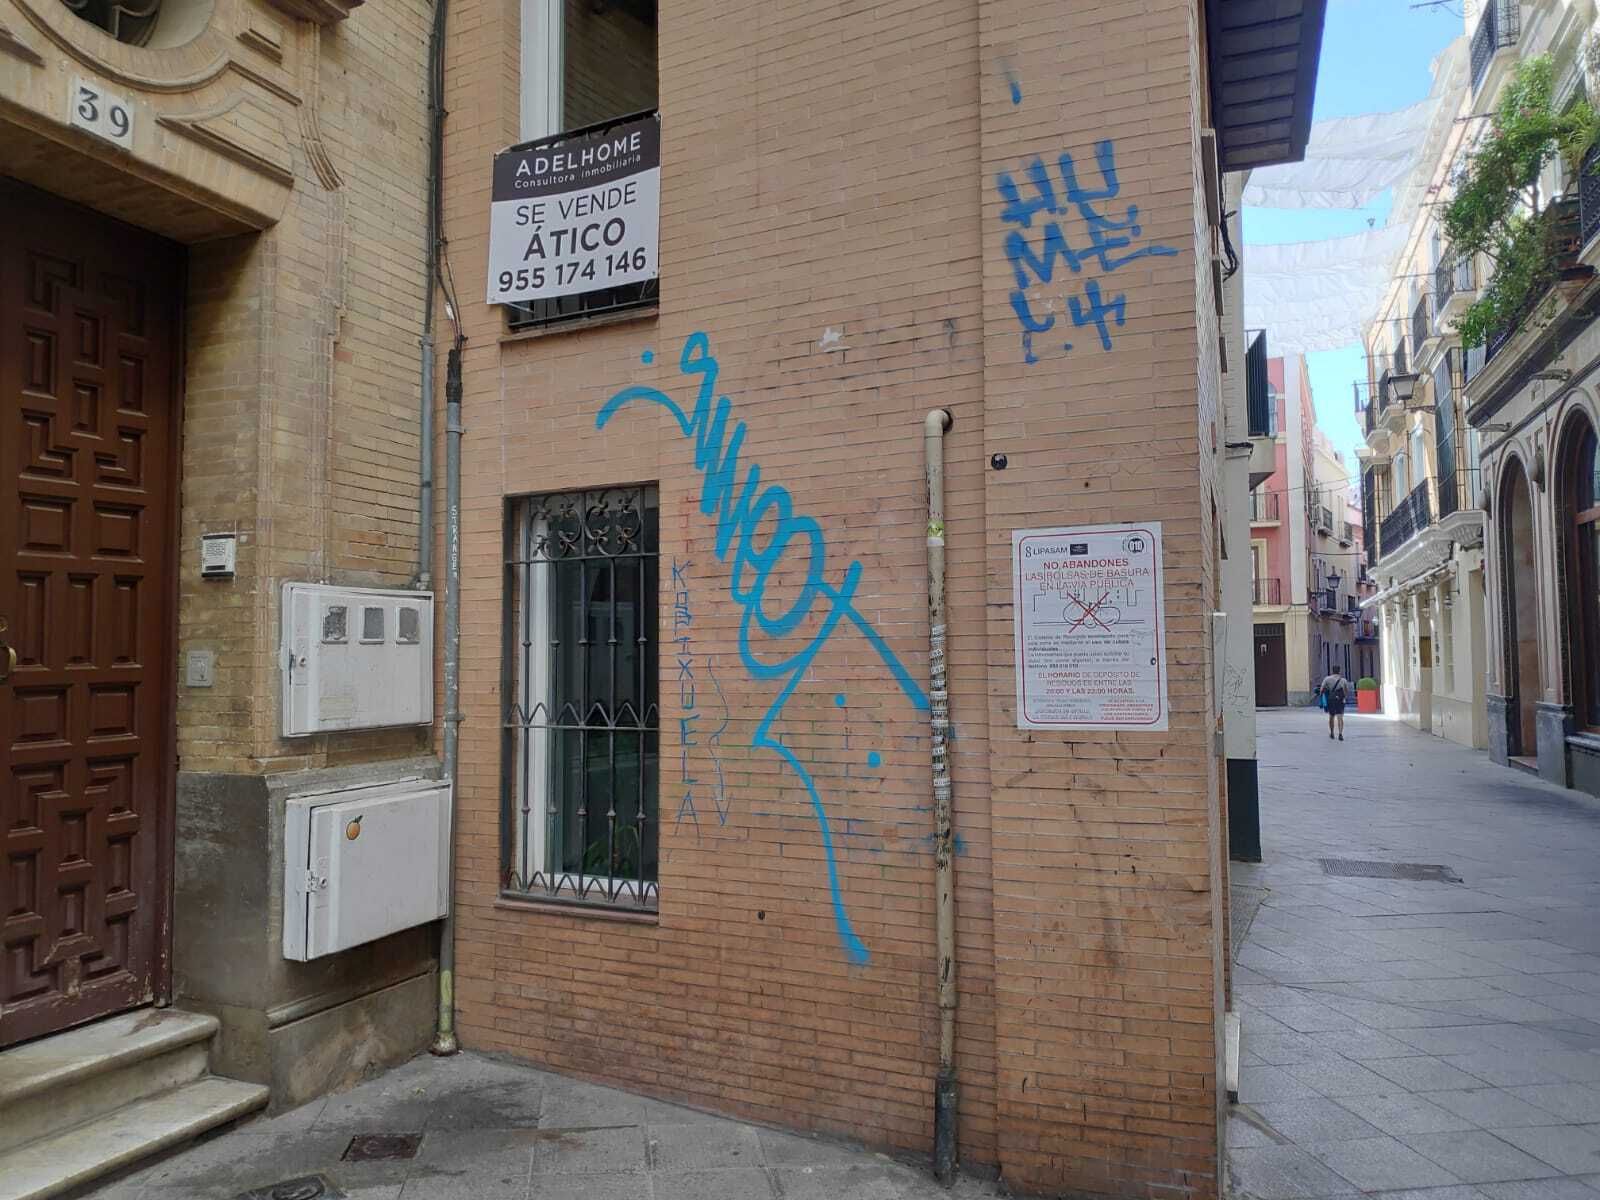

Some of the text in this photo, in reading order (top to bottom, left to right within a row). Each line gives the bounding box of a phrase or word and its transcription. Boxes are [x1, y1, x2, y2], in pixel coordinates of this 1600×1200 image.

[78, 86, 129, 138] 39
[514, 154, 642, 190] Consultora inmobiliaria
[515, 131, 642, 178] ADELHOME
[515, 181, 638, 226] SE VENDE
[522, 216, 627, 262] ÁTICO
[499, 246, 648, 293] 955 174 146
[1033, 546, 1068, 556] LIPASAM
[1043, 558, 1129, 570] NO ABANDONES
[1106, 567, 1149, 578] BASURA
